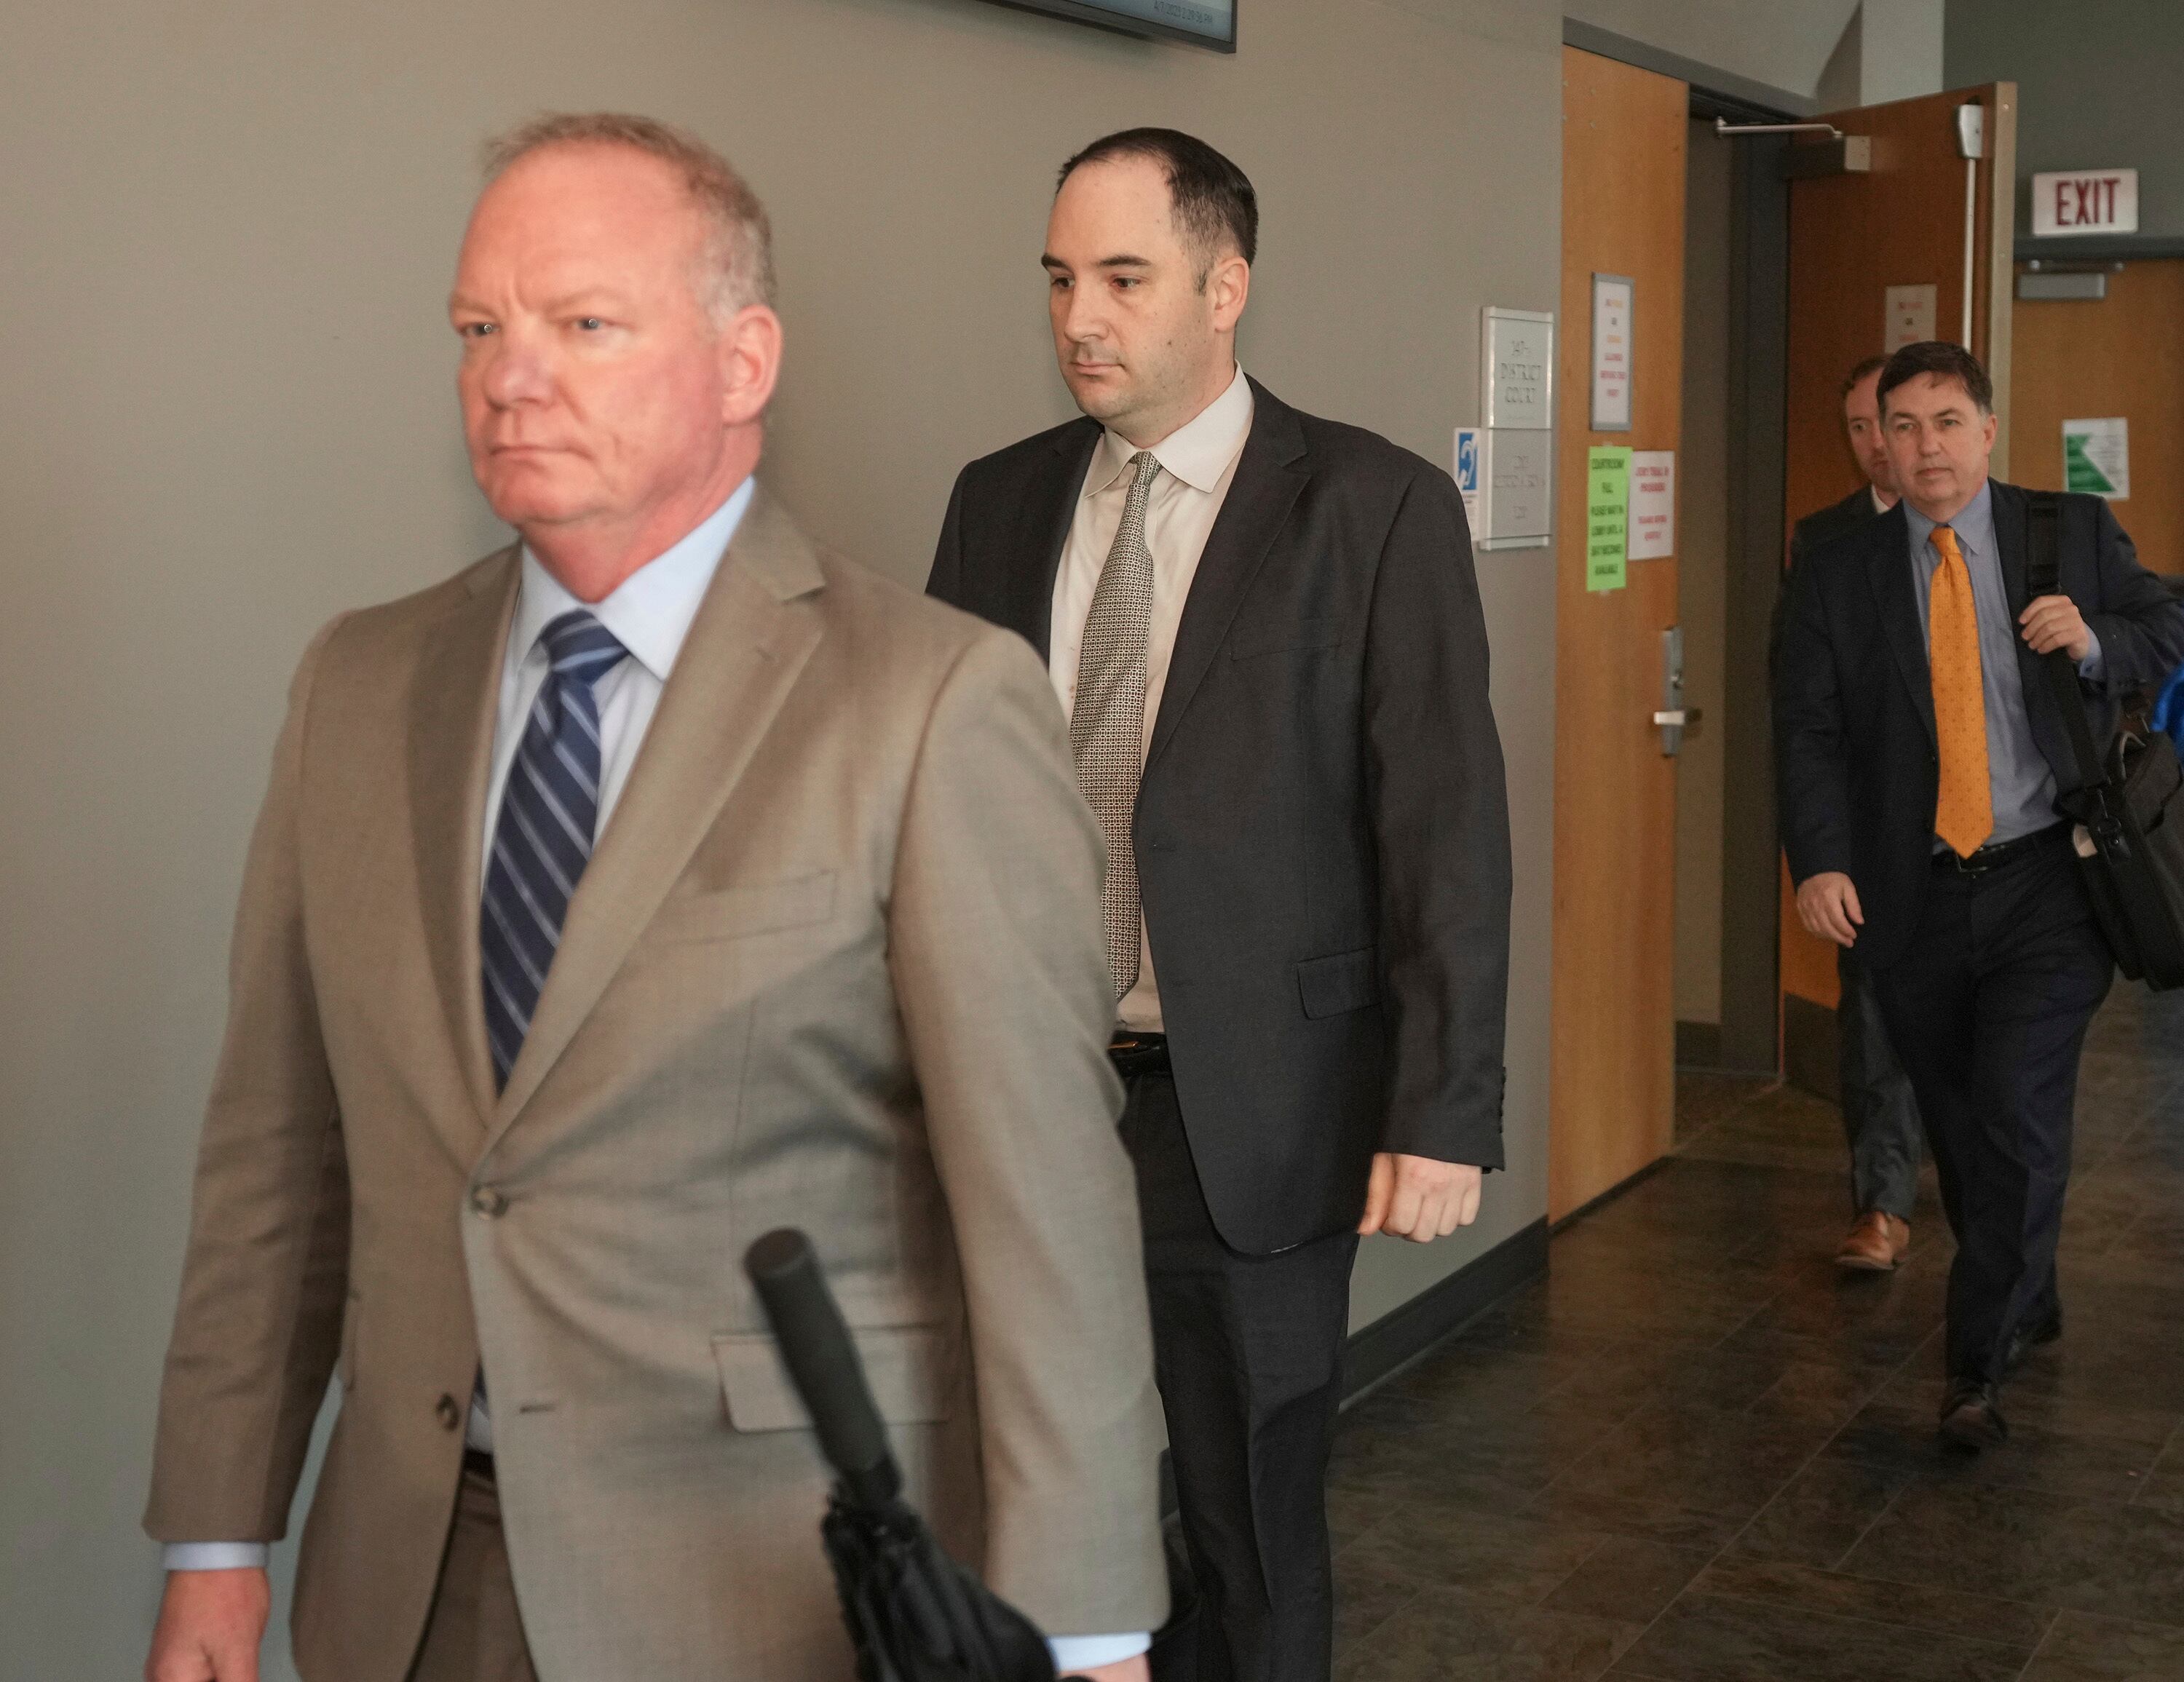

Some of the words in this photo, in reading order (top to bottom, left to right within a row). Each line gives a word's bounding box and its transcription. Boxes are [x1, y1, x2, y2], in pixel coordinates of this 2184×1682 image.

[2056, 178, 2121, 225] EXIT
[1500, 362, 1541, 380] DISTRICT
[1505, 386, 1535, 403] COURT
